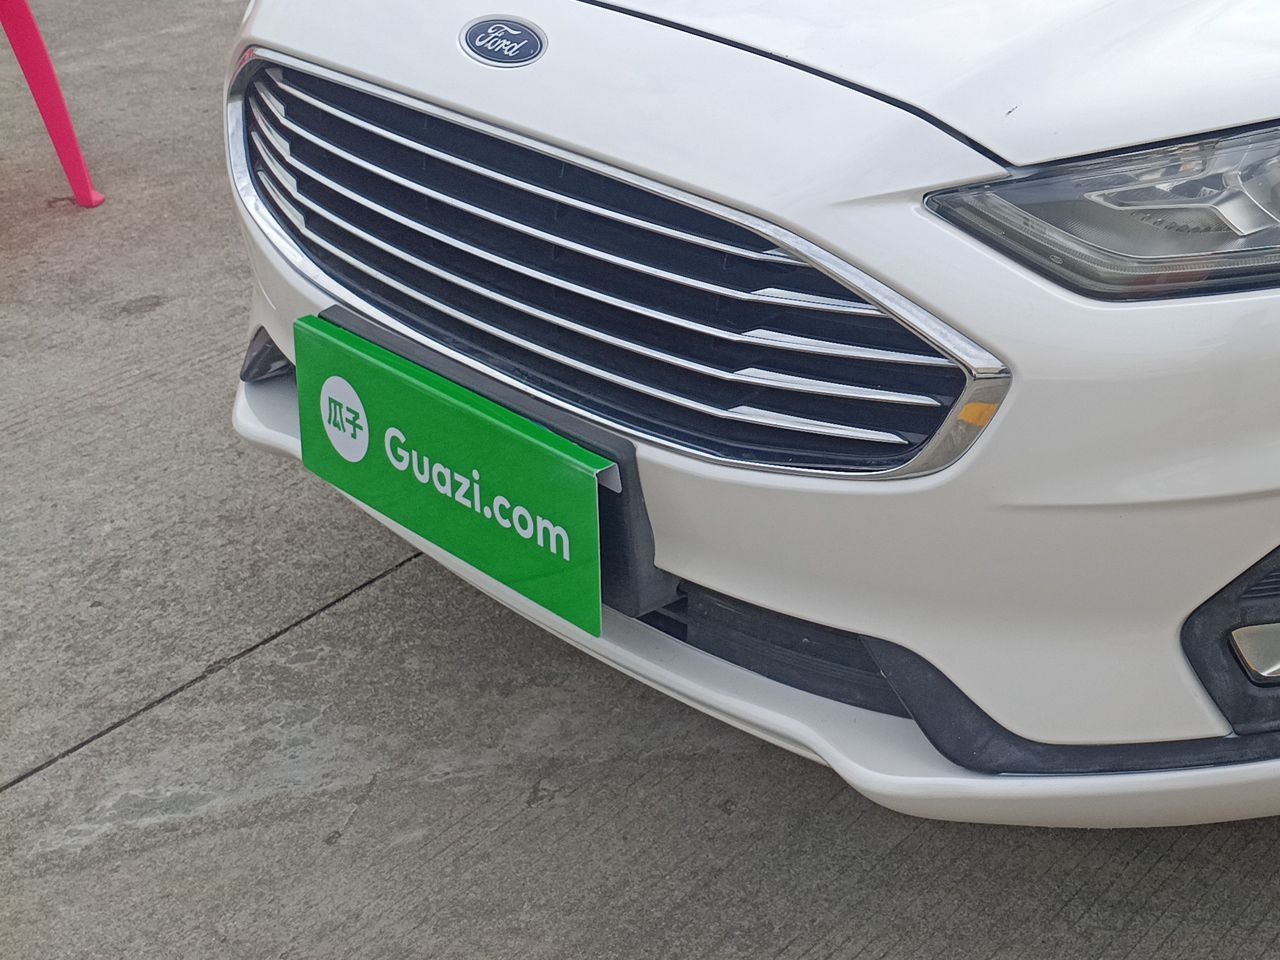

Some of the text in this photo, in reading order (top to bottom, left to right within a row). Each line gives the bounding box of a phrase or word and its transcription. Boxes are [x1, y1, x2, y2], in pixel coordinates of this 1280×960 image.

[475, 23, 528, 57] Ford
[327, 395, 571, 562] 瓜子 Guazi.com
